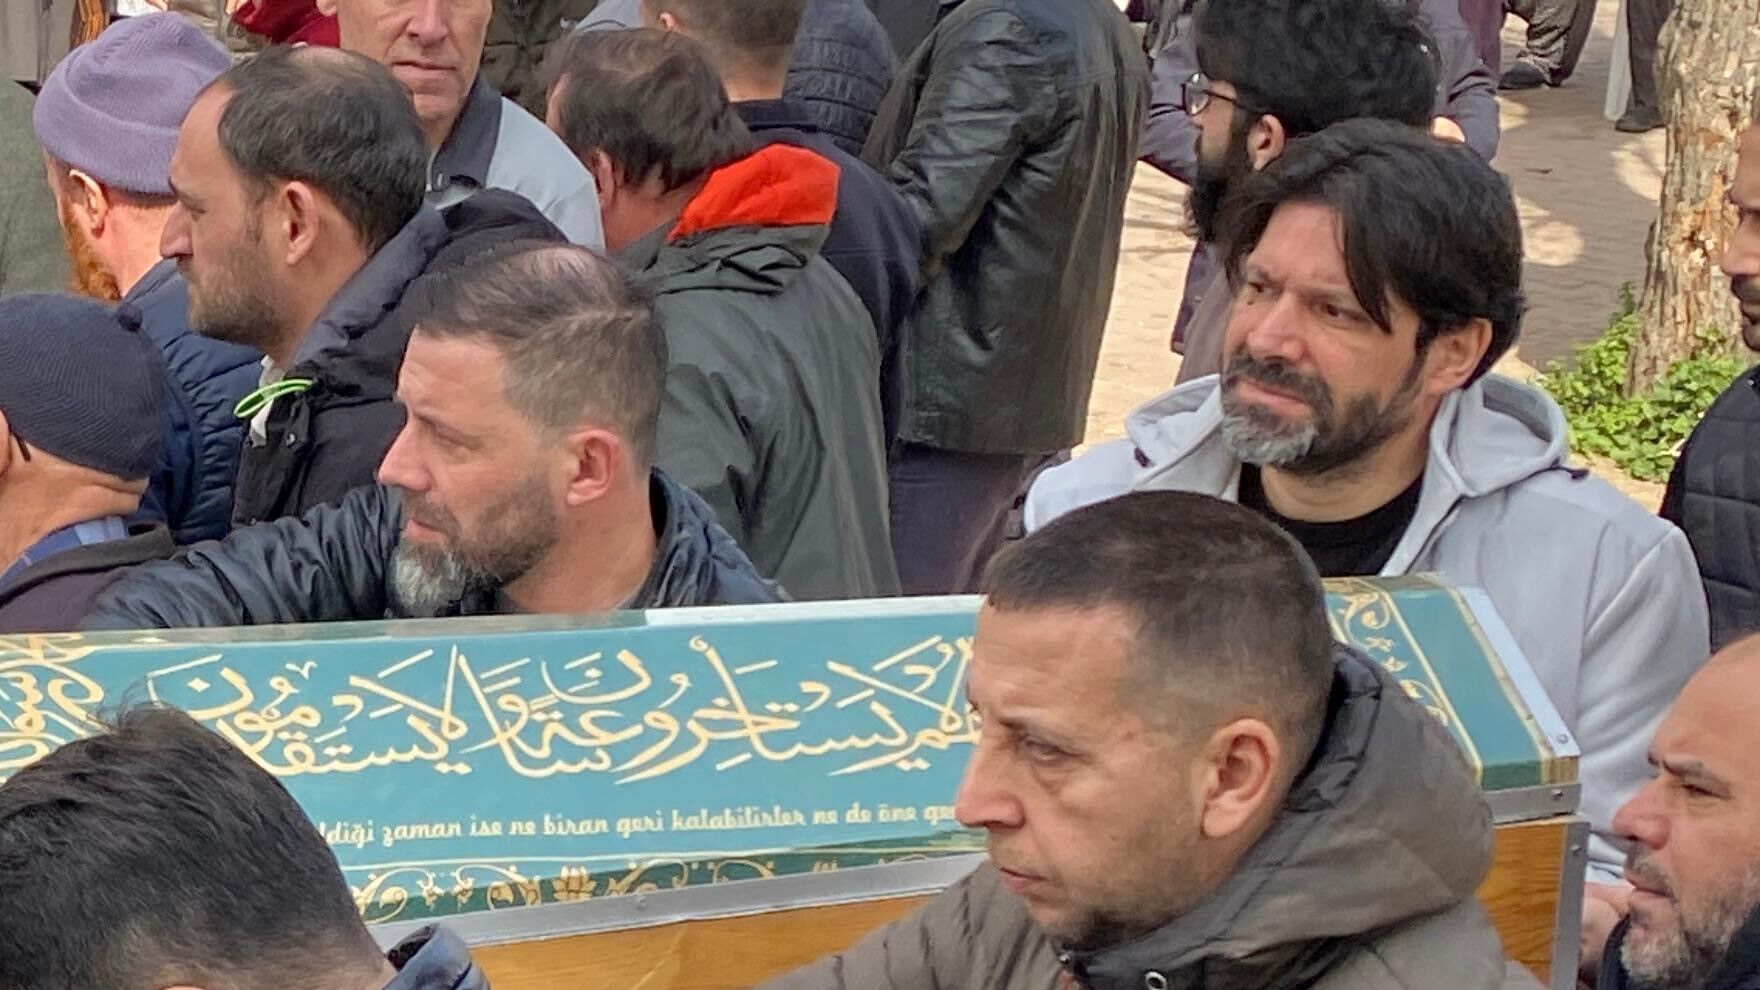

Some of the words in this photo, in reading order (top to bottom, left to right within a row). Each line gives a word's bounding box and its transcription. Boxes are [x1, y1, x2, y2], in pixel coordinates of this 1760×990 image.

[319, 819, 375, 849] ldiği
[382, 819, 462, 847] zaman
[469, 814, 503, 837] ise
[508, 819, 536, 837] ne
[542, 809, 610, 837] biran
[616, 810, 664, 838] geri
[671, 805, 807, 831] kalabilirler
[812, 808, 839, 825] ne
[845, 801, 873, 824] de
